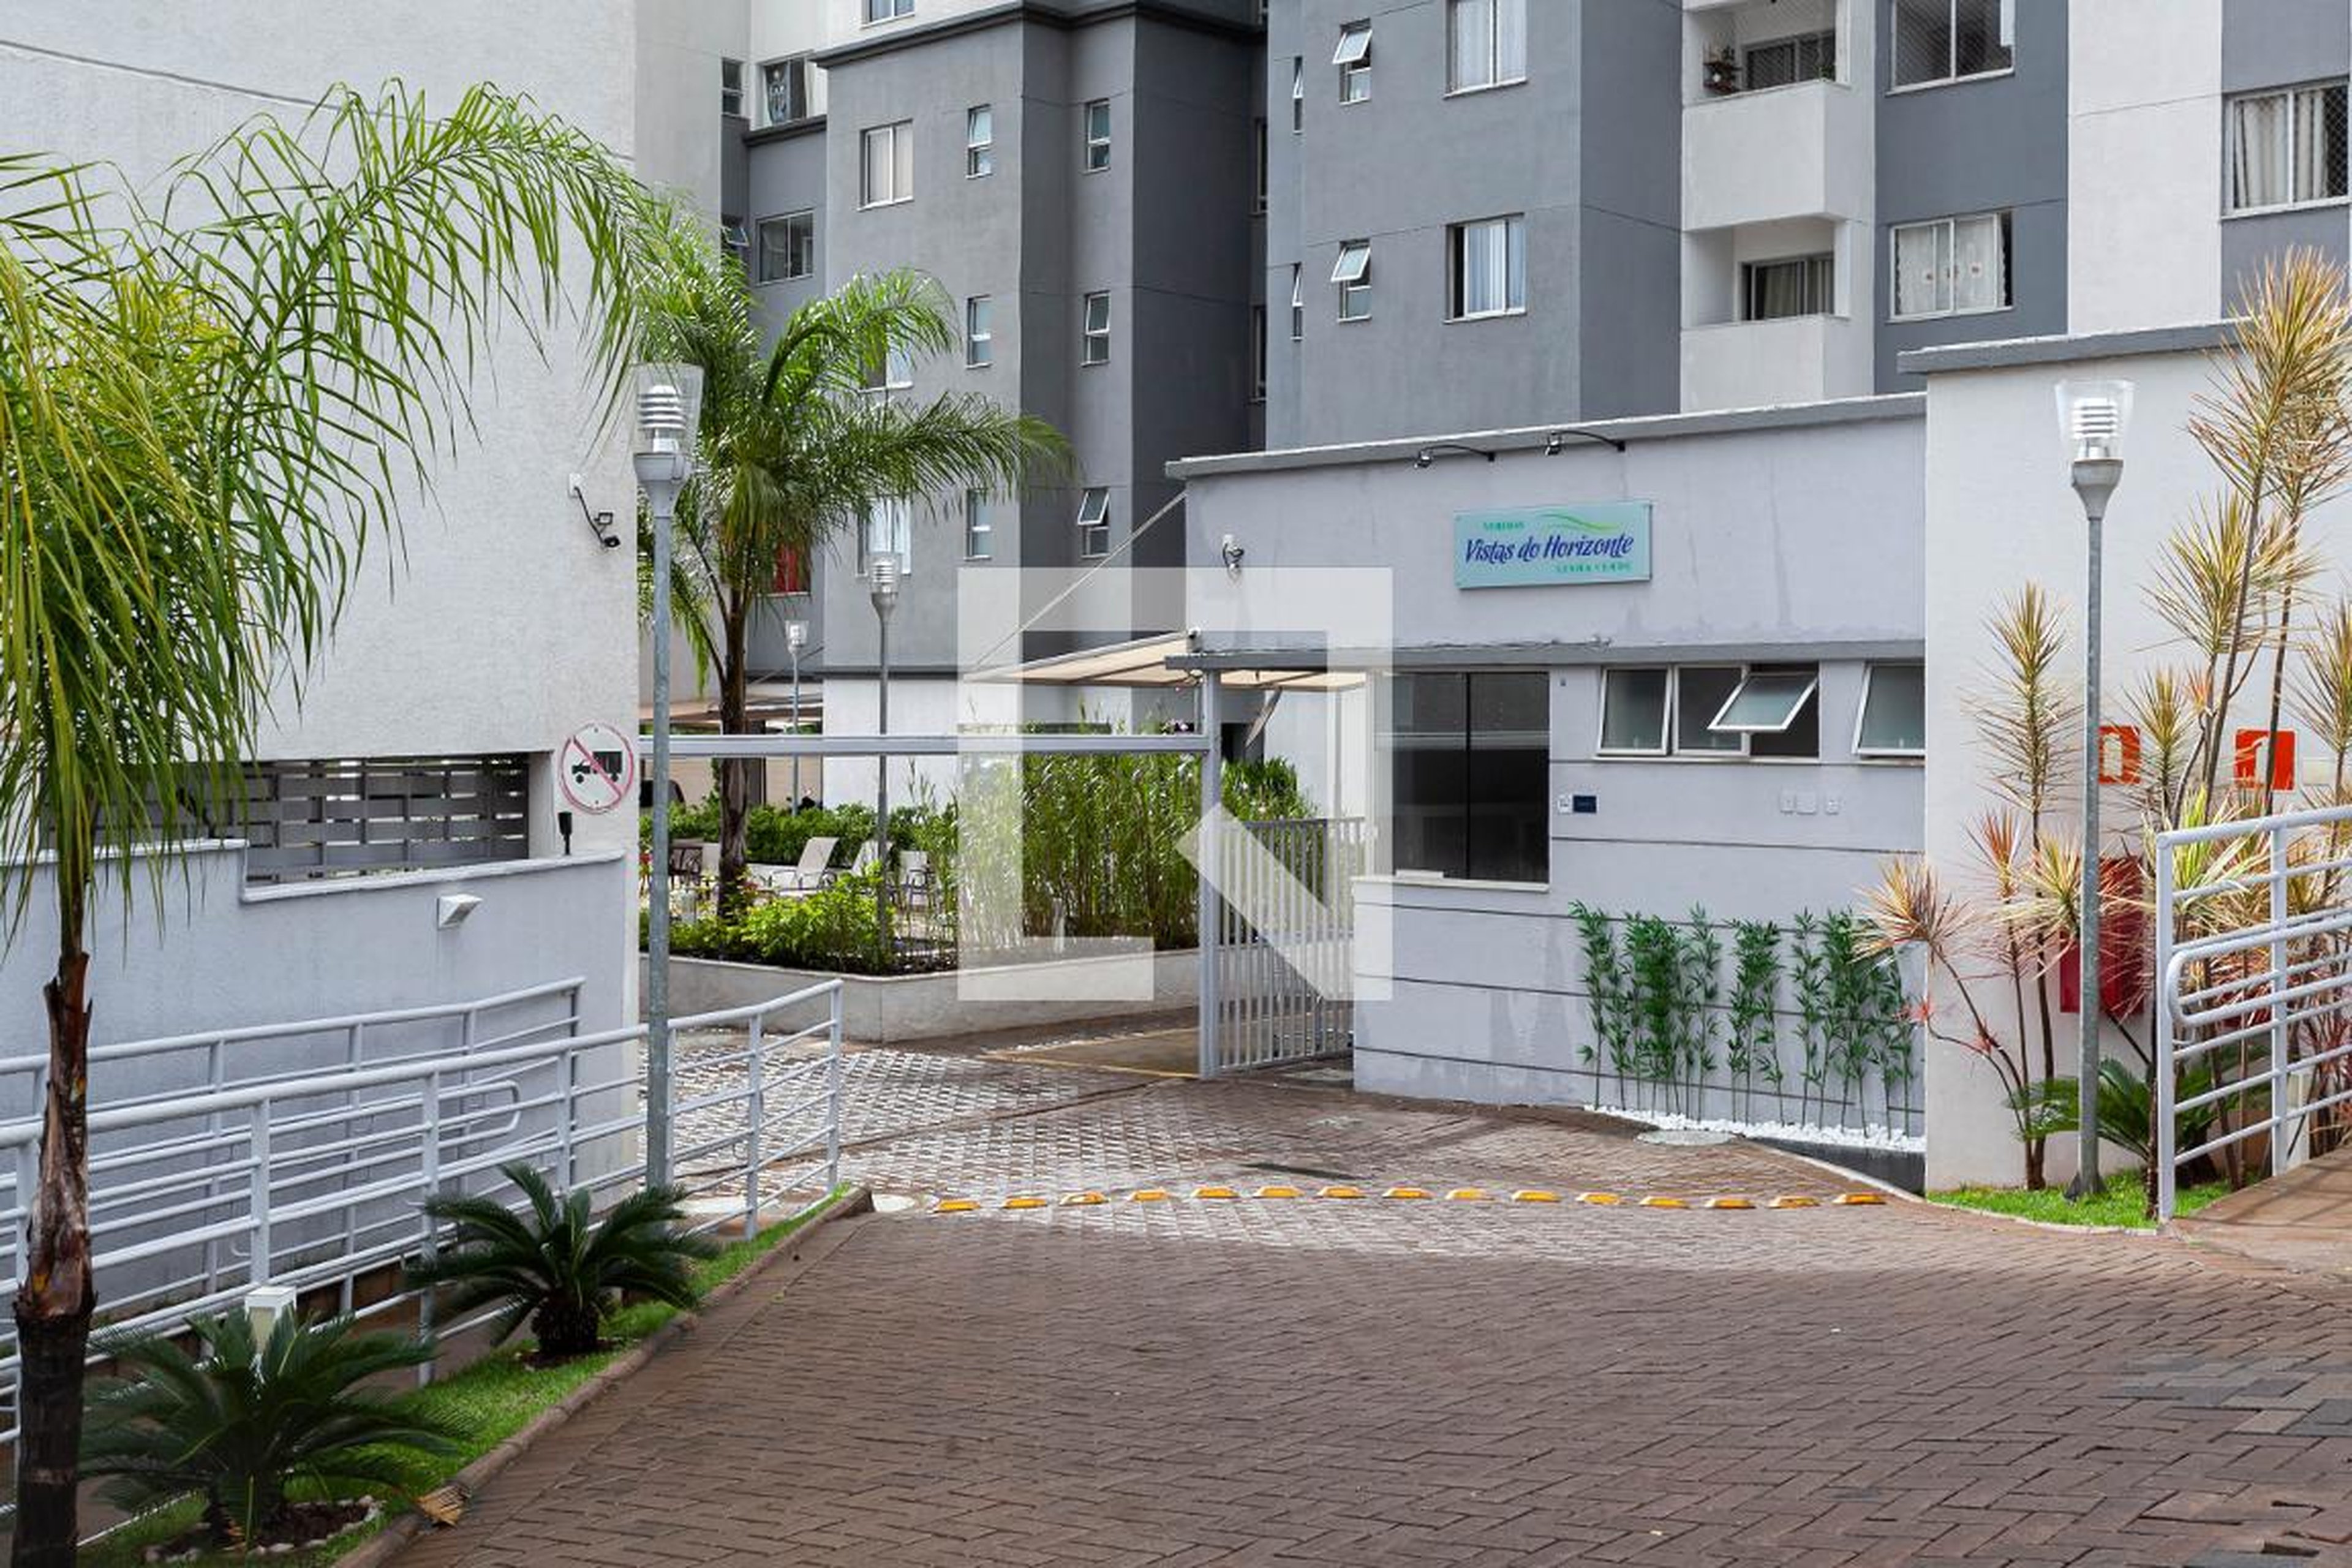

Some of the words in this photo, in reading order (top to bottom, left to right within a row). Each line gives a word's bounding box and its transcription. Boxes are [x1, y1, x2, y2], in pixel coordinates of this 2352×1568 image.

[1465, 538, 1514, 564] Vistas
[1518, 537, 1541, 562] do
[1543, 533, 1634, 559] Horizonte
